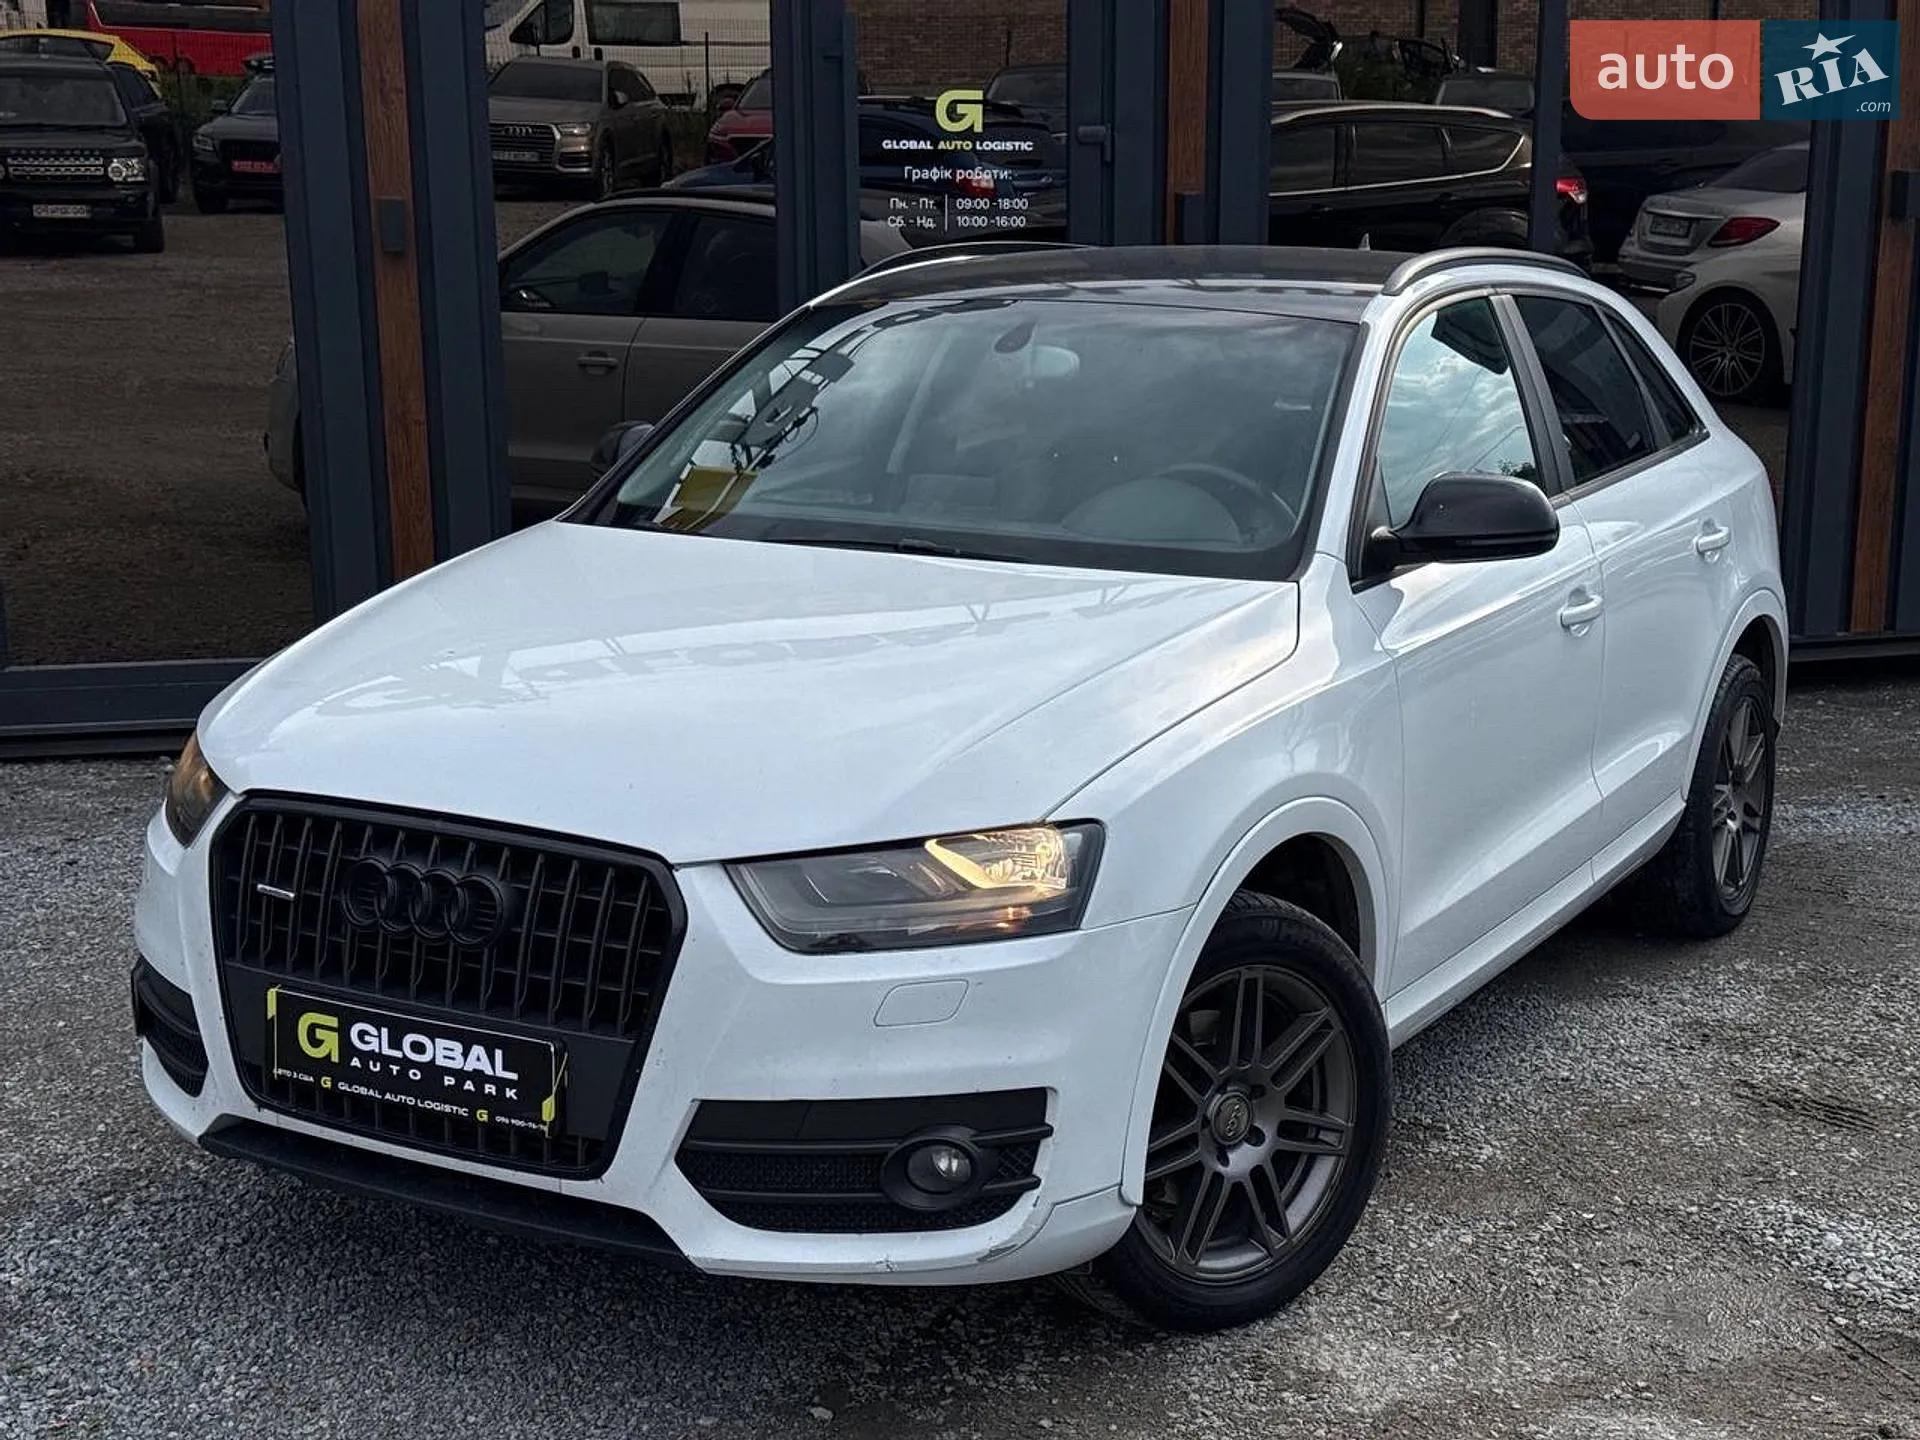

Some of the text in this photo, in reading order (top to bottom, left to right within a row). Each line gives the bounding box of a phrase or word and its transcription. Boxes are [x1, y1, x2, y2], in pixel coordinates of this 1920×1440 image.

[882, 140, 1034, 152] GLOBAL AUTO LOGISTIC
[904, 165, 1013, 183] Графік роботи:
[889, 198, 908, 210] Пн.
[919, 197, 937, 210] Пт.
[955, 198, 989, 210] 09:00
[956, 216, 988, 228] 10:00
[349, 1021, 519, 1081] GLOBAL
[349, 1056, 519, 1101] AUTO PARK
[337, 1081, 382, 1100] GLOBAL
[384, 1091, 415, 1106] AUTO
[417, 1096, 469, 1118] LOGISTIC
